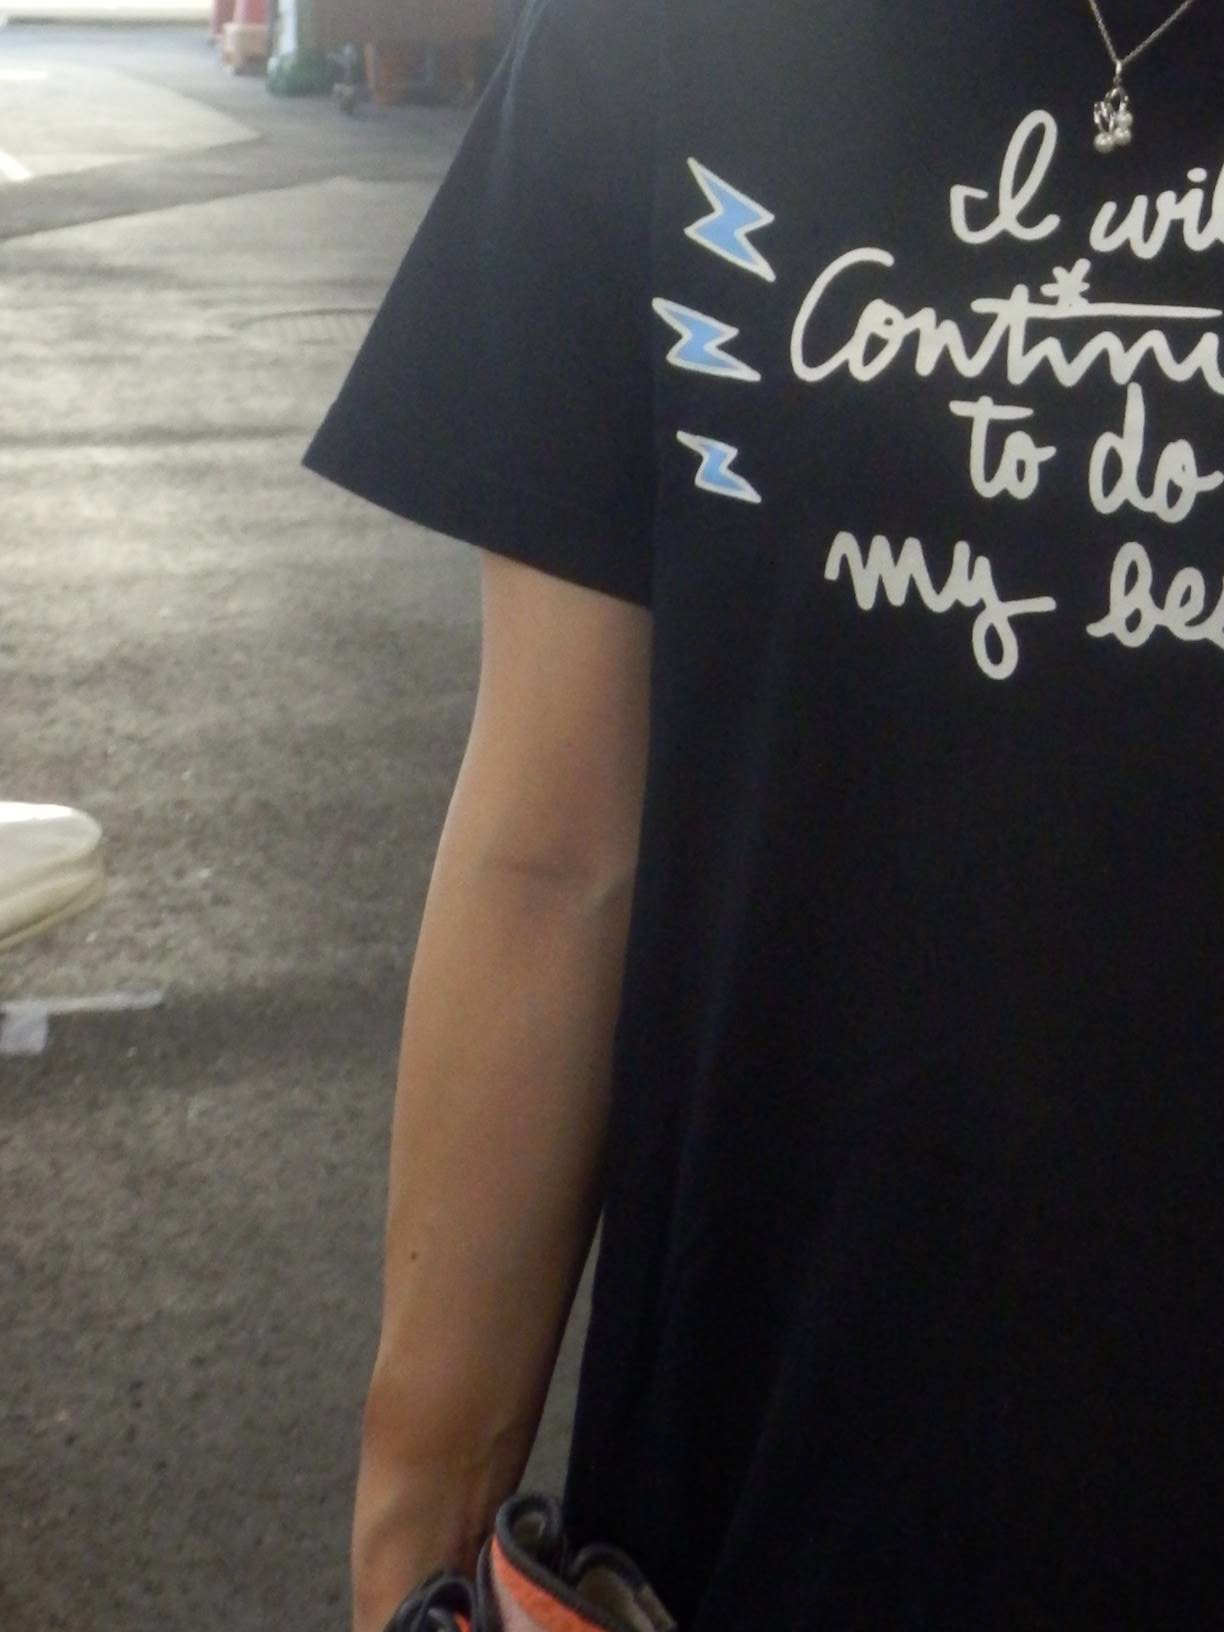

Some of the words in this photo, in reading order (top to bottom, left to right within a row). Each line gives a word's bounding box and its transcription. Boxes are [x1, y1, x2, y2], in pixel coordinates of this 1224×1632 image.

[949, 109, 1062, 246] I
[948, 394, 1058, 500] to
[824, 531, 1057, 681] my
